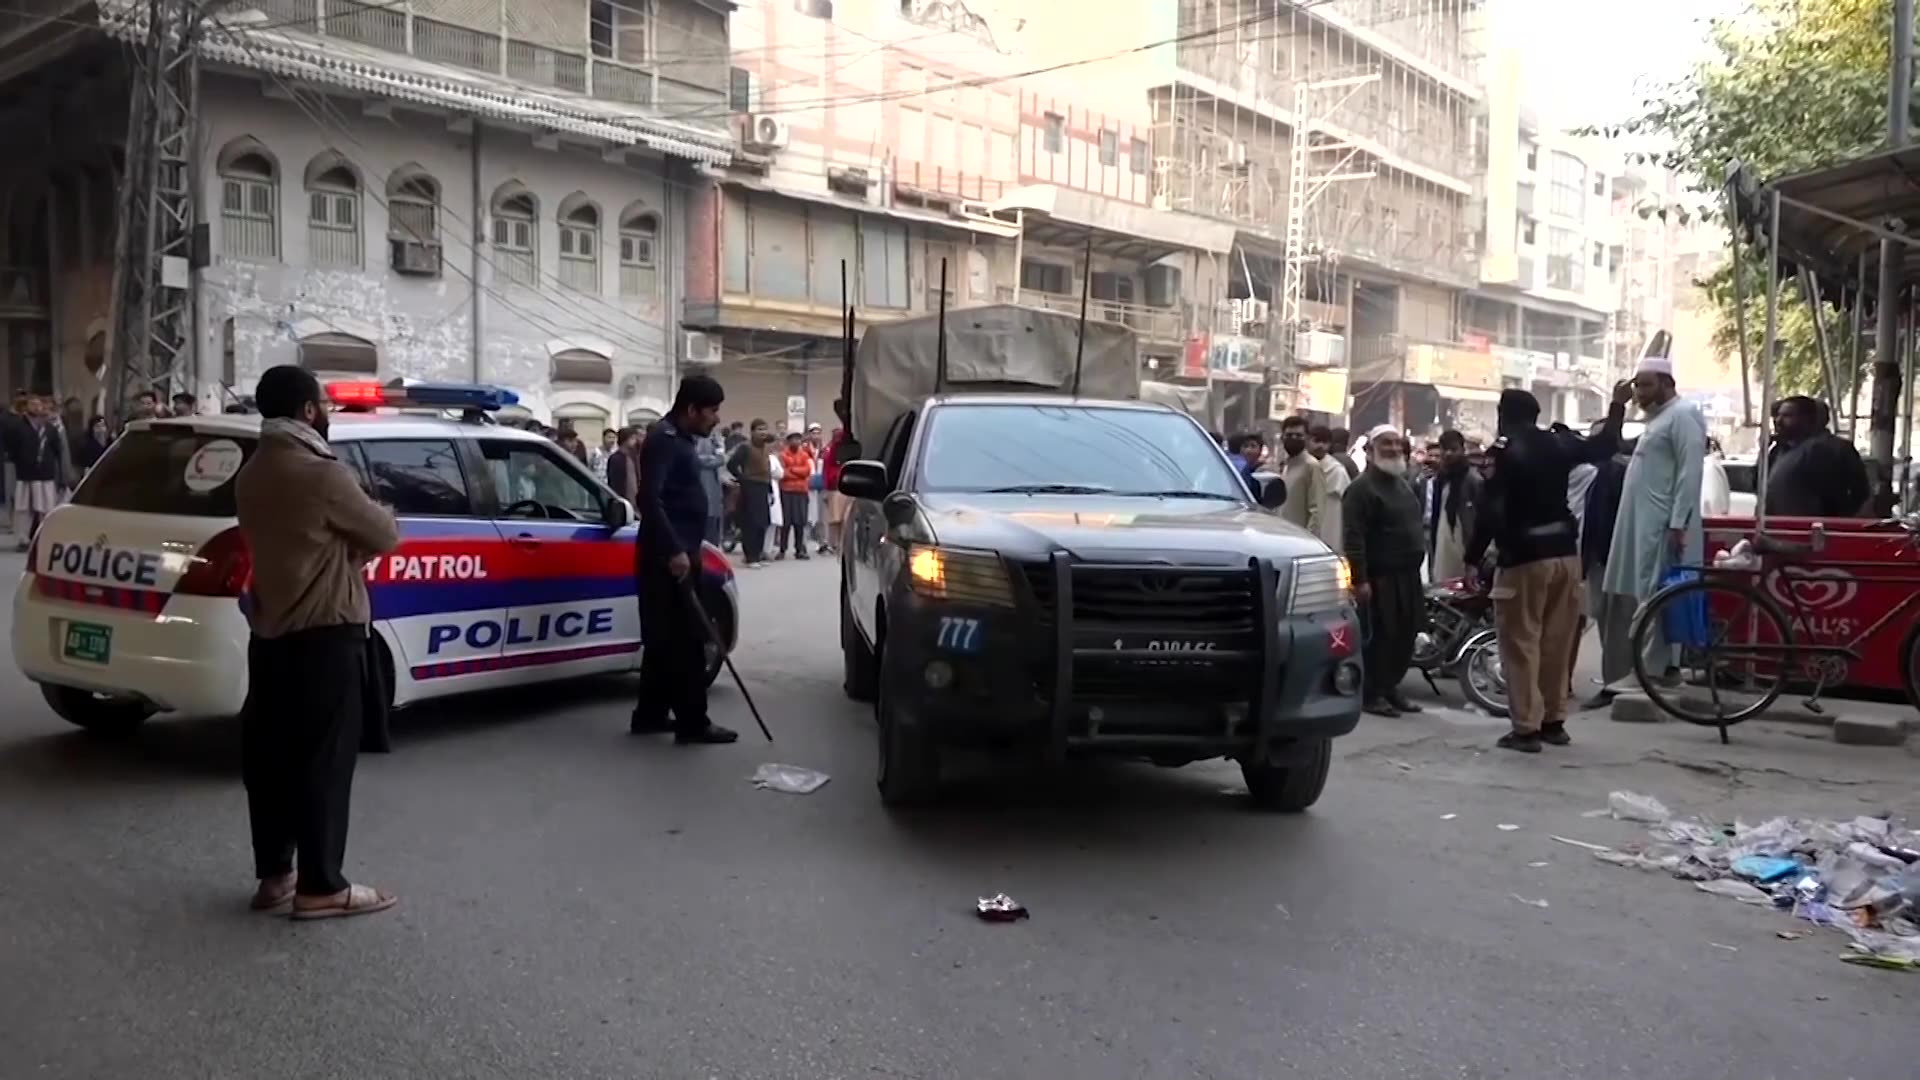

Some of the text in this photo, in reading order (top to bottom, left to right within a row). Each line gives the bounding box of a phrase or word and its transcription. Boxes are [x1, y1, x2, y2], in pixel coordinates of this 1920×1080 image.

[47, 541, 162, 586] POLICE
[389, 555, 488, 581] PATROL
[428, 607, 613, 655] POLICE
[937, 616, 979, 650] 777
